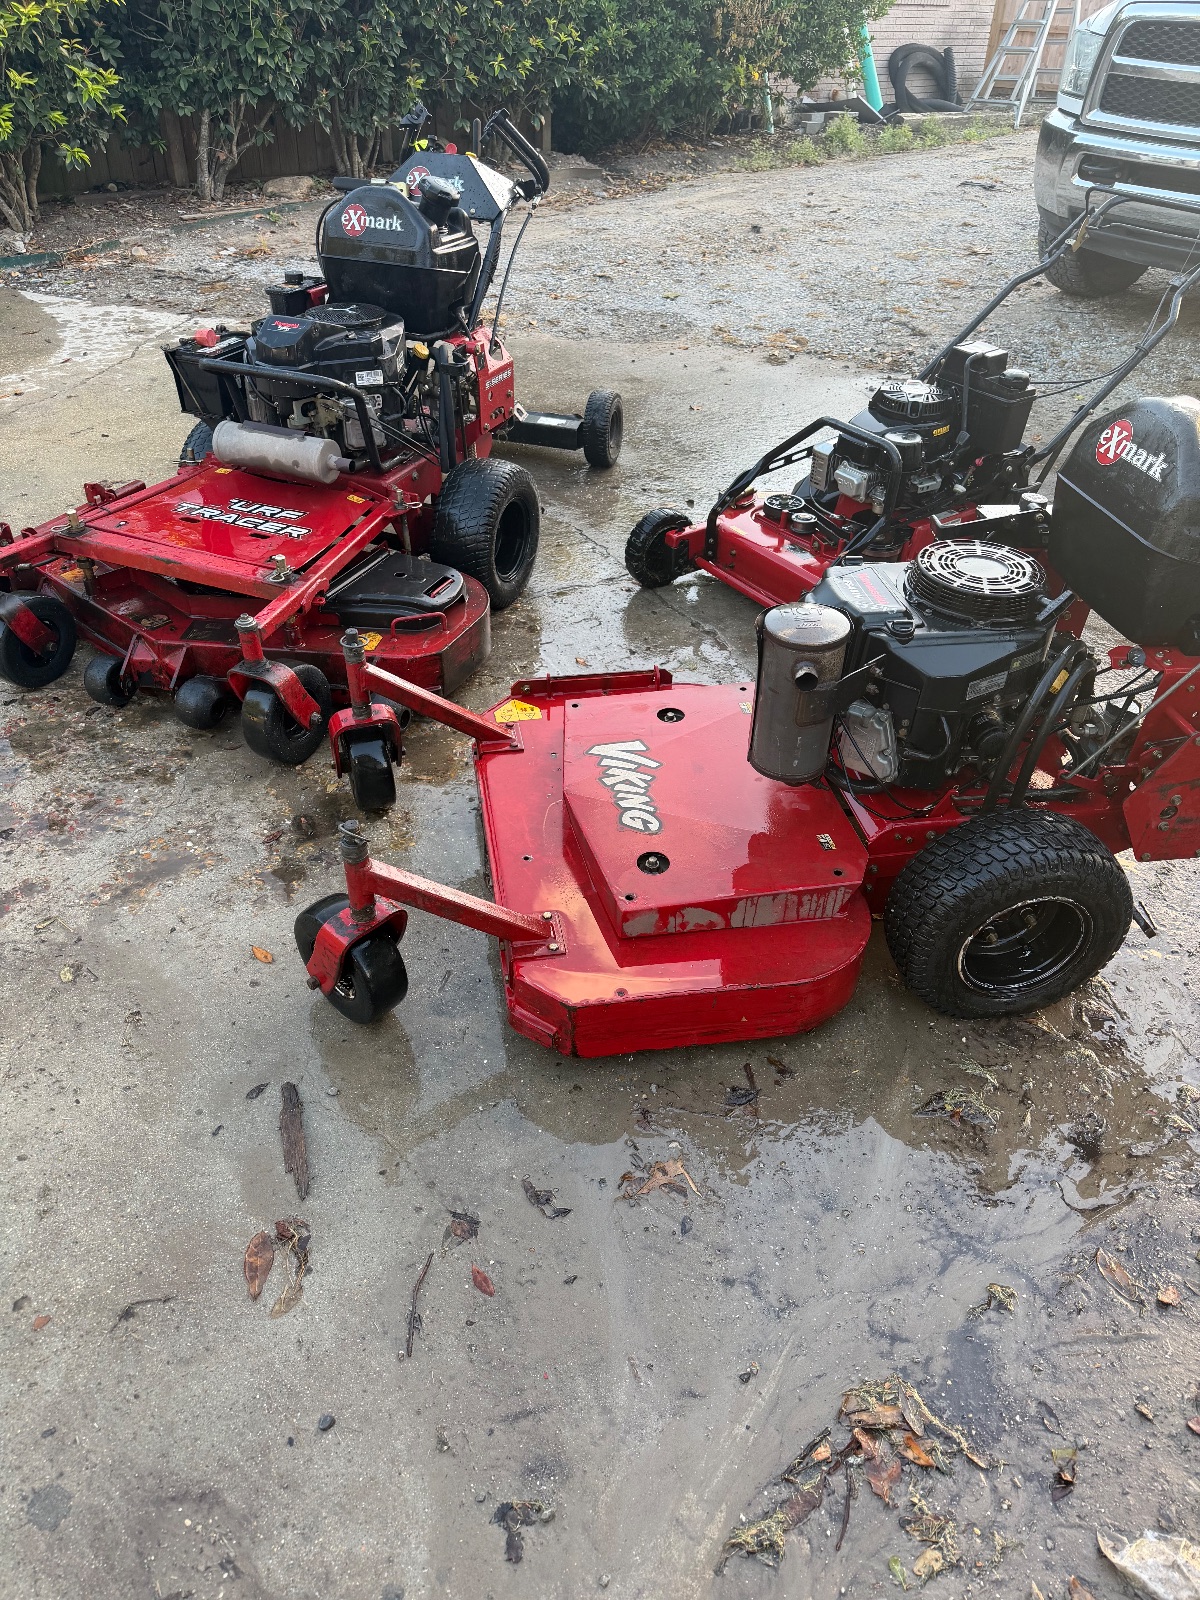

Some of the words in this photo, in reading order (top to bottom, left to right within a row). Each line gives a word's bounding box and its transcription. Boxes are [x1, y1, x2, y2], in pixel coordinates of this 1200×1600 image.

[171, 501, 312, 540] TRACER
[228, 498, 310, 521] URF
[585, 740, 662, 833] VIKING
